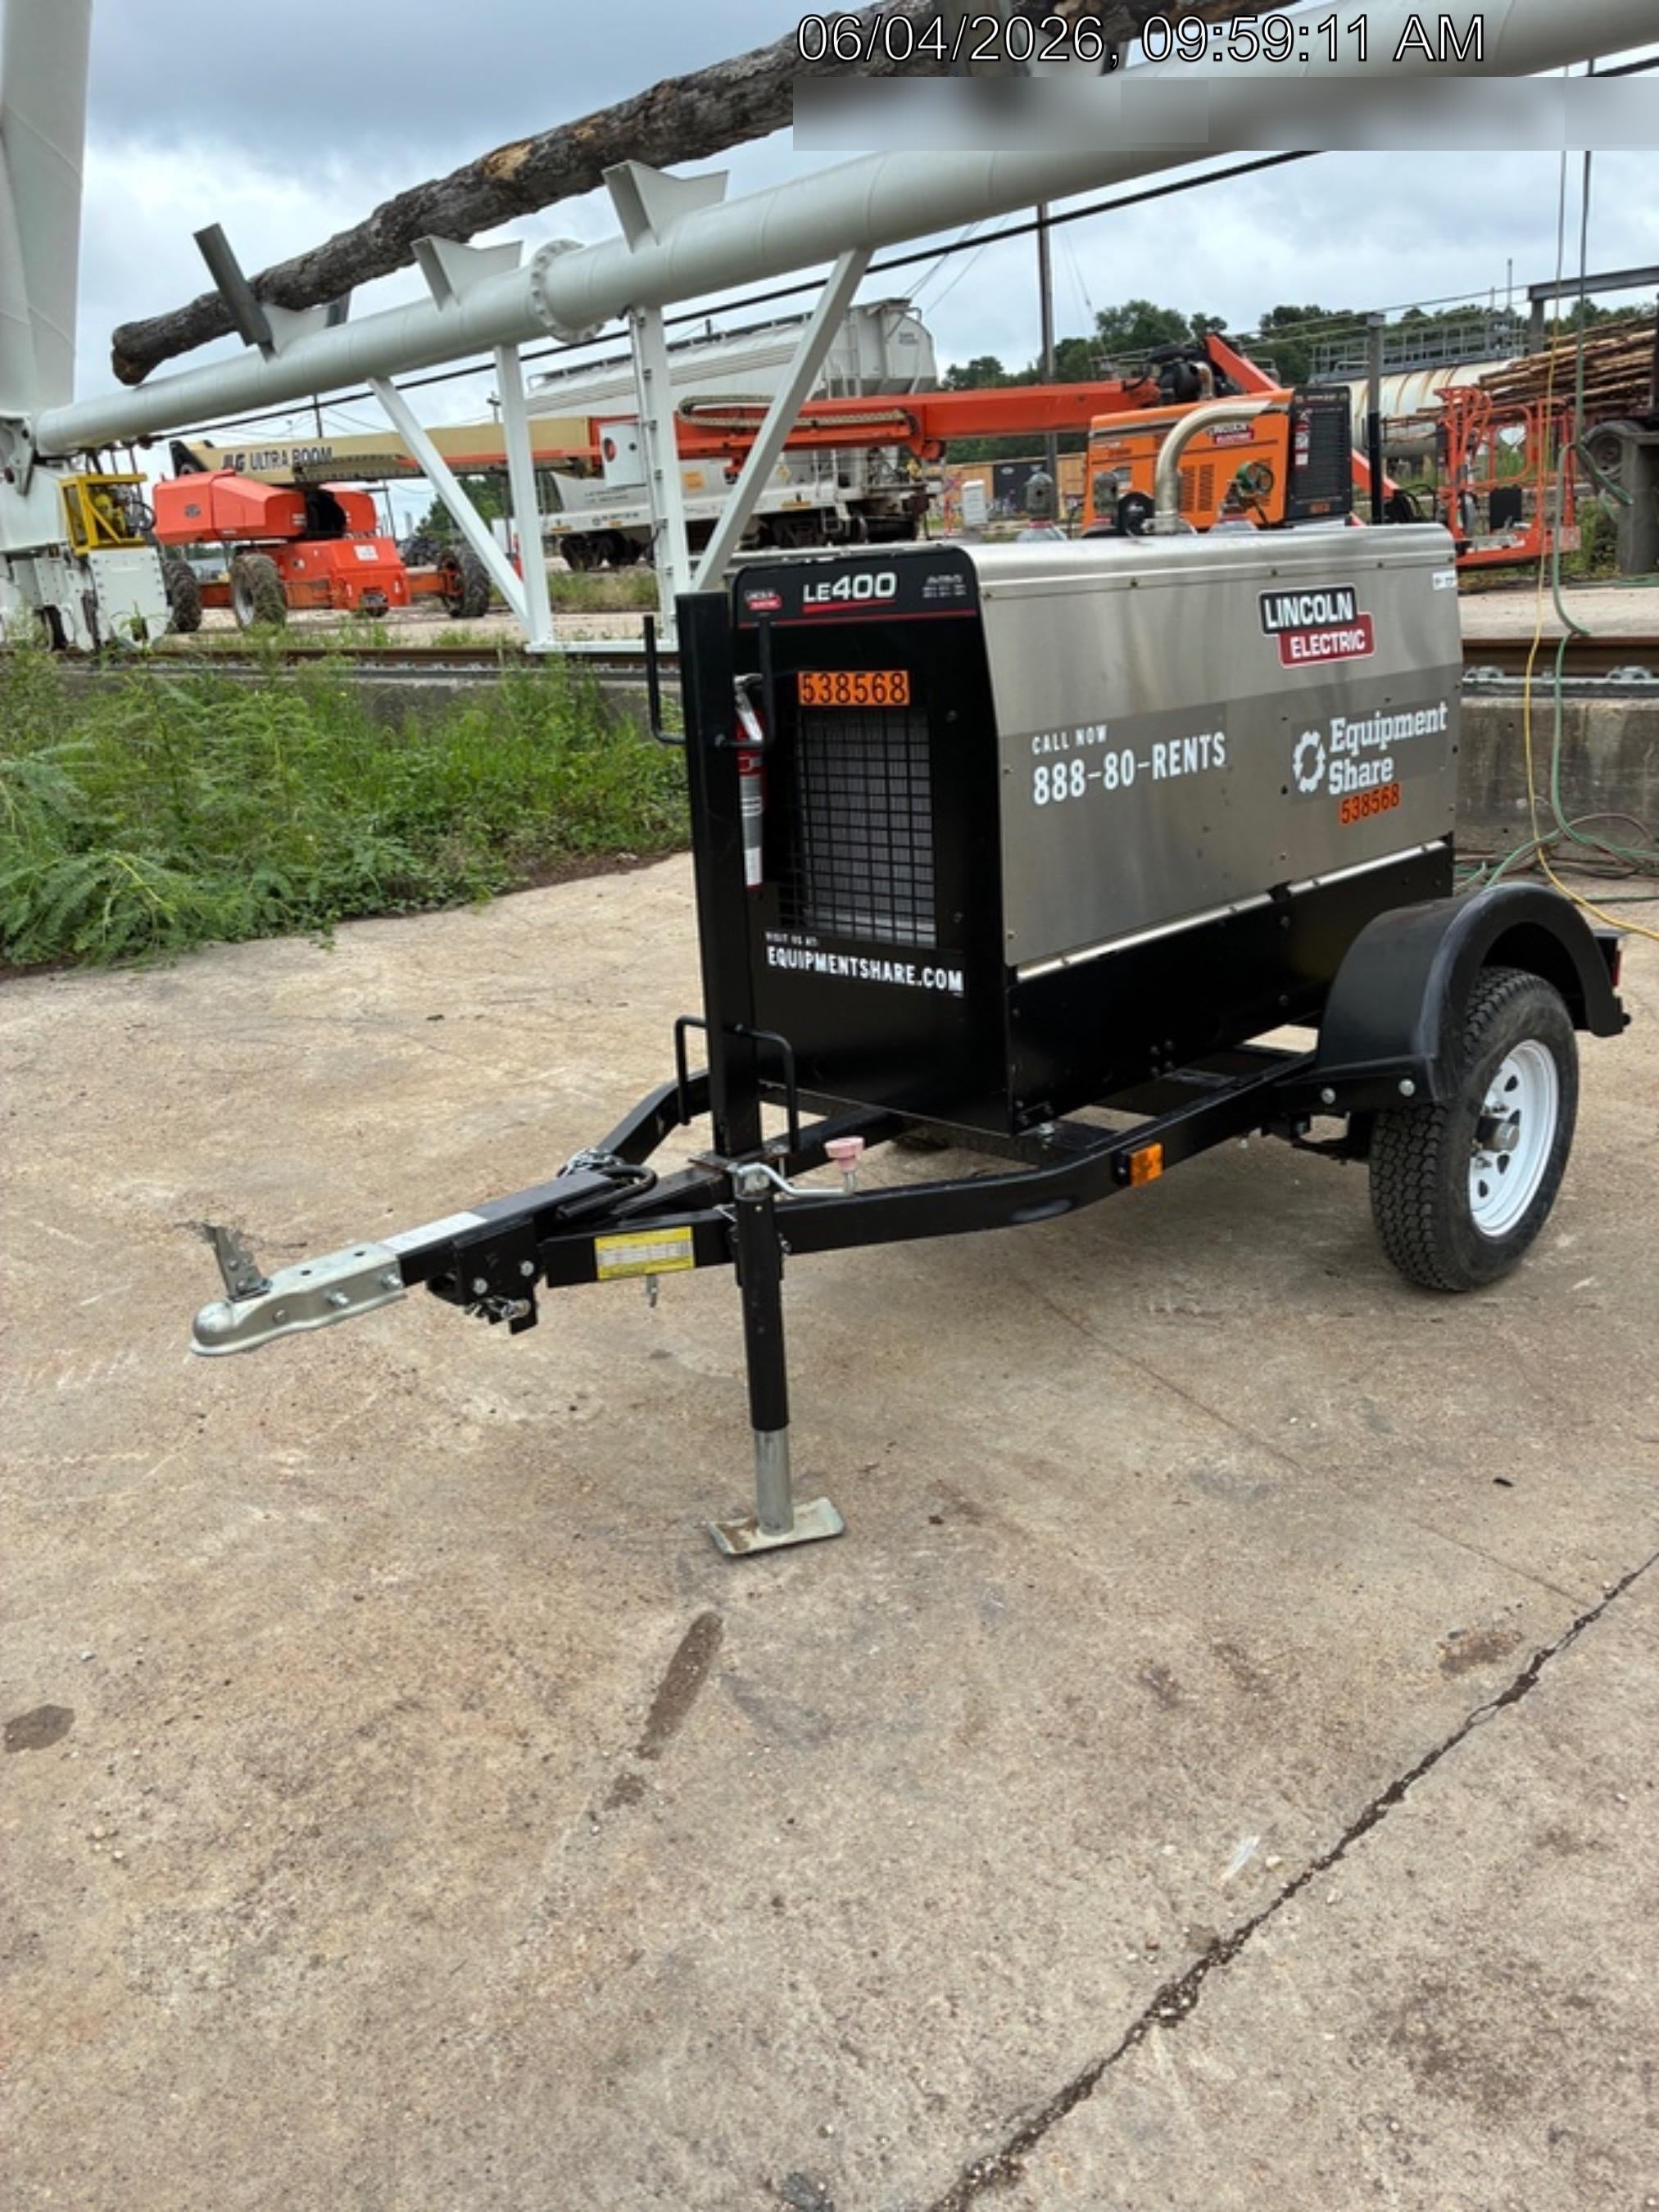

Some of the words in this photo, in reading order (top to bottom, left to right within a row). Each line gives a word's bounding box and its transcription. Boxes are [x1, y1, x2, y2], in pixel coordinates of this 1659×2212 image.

[250, 449, 288, 469] ULTRA
[292, 446, 333, 466] BOOM
[803, 572, 896, 603] LE400
[1264, 590, 1353, 629] LINCOLN
[1290, 628, 1366, 659] ELECTRIC
[800, 672, 908, 705] 538568
[1031, 732, 1070, 755] CALL
[1075, 725, 1108, 746] NOW
[1330, 700, 1448, 758] Equipment
[1032, 732, 1226, 807] 888-80-RENTS
[1330, 755, 1394, 796] Share
[1340, 784, 1400, 825] 538568
[766, 945, 964, 992] EQUIPMENTSHARE.COM
